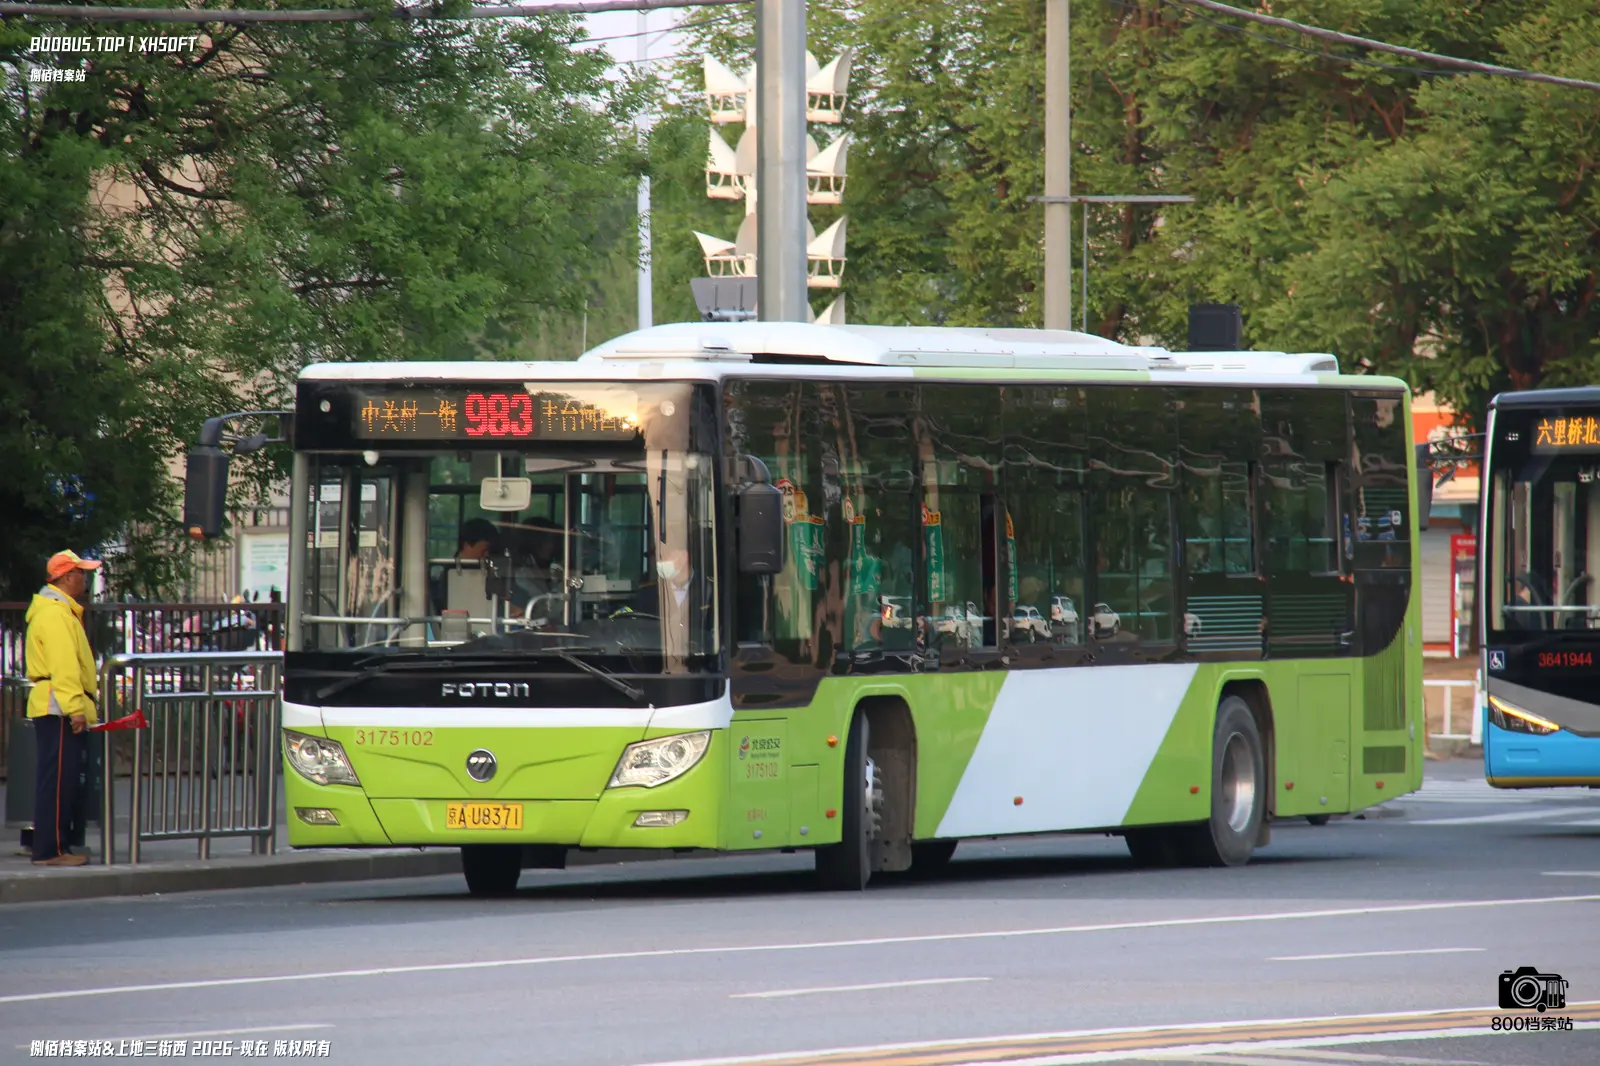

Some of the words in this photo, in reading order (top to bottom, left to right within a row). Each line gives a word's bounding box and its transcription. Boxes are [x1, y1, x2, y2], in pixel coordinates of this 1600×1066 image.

[464, 393, 533, 436] 983
[1536, 416, 1600, 445] 六里桥北
[1539, 652, 1592, 667] 3641944
[441, 682, 530, 698] FOTON
[355, 730, 434, 746] 3175102
